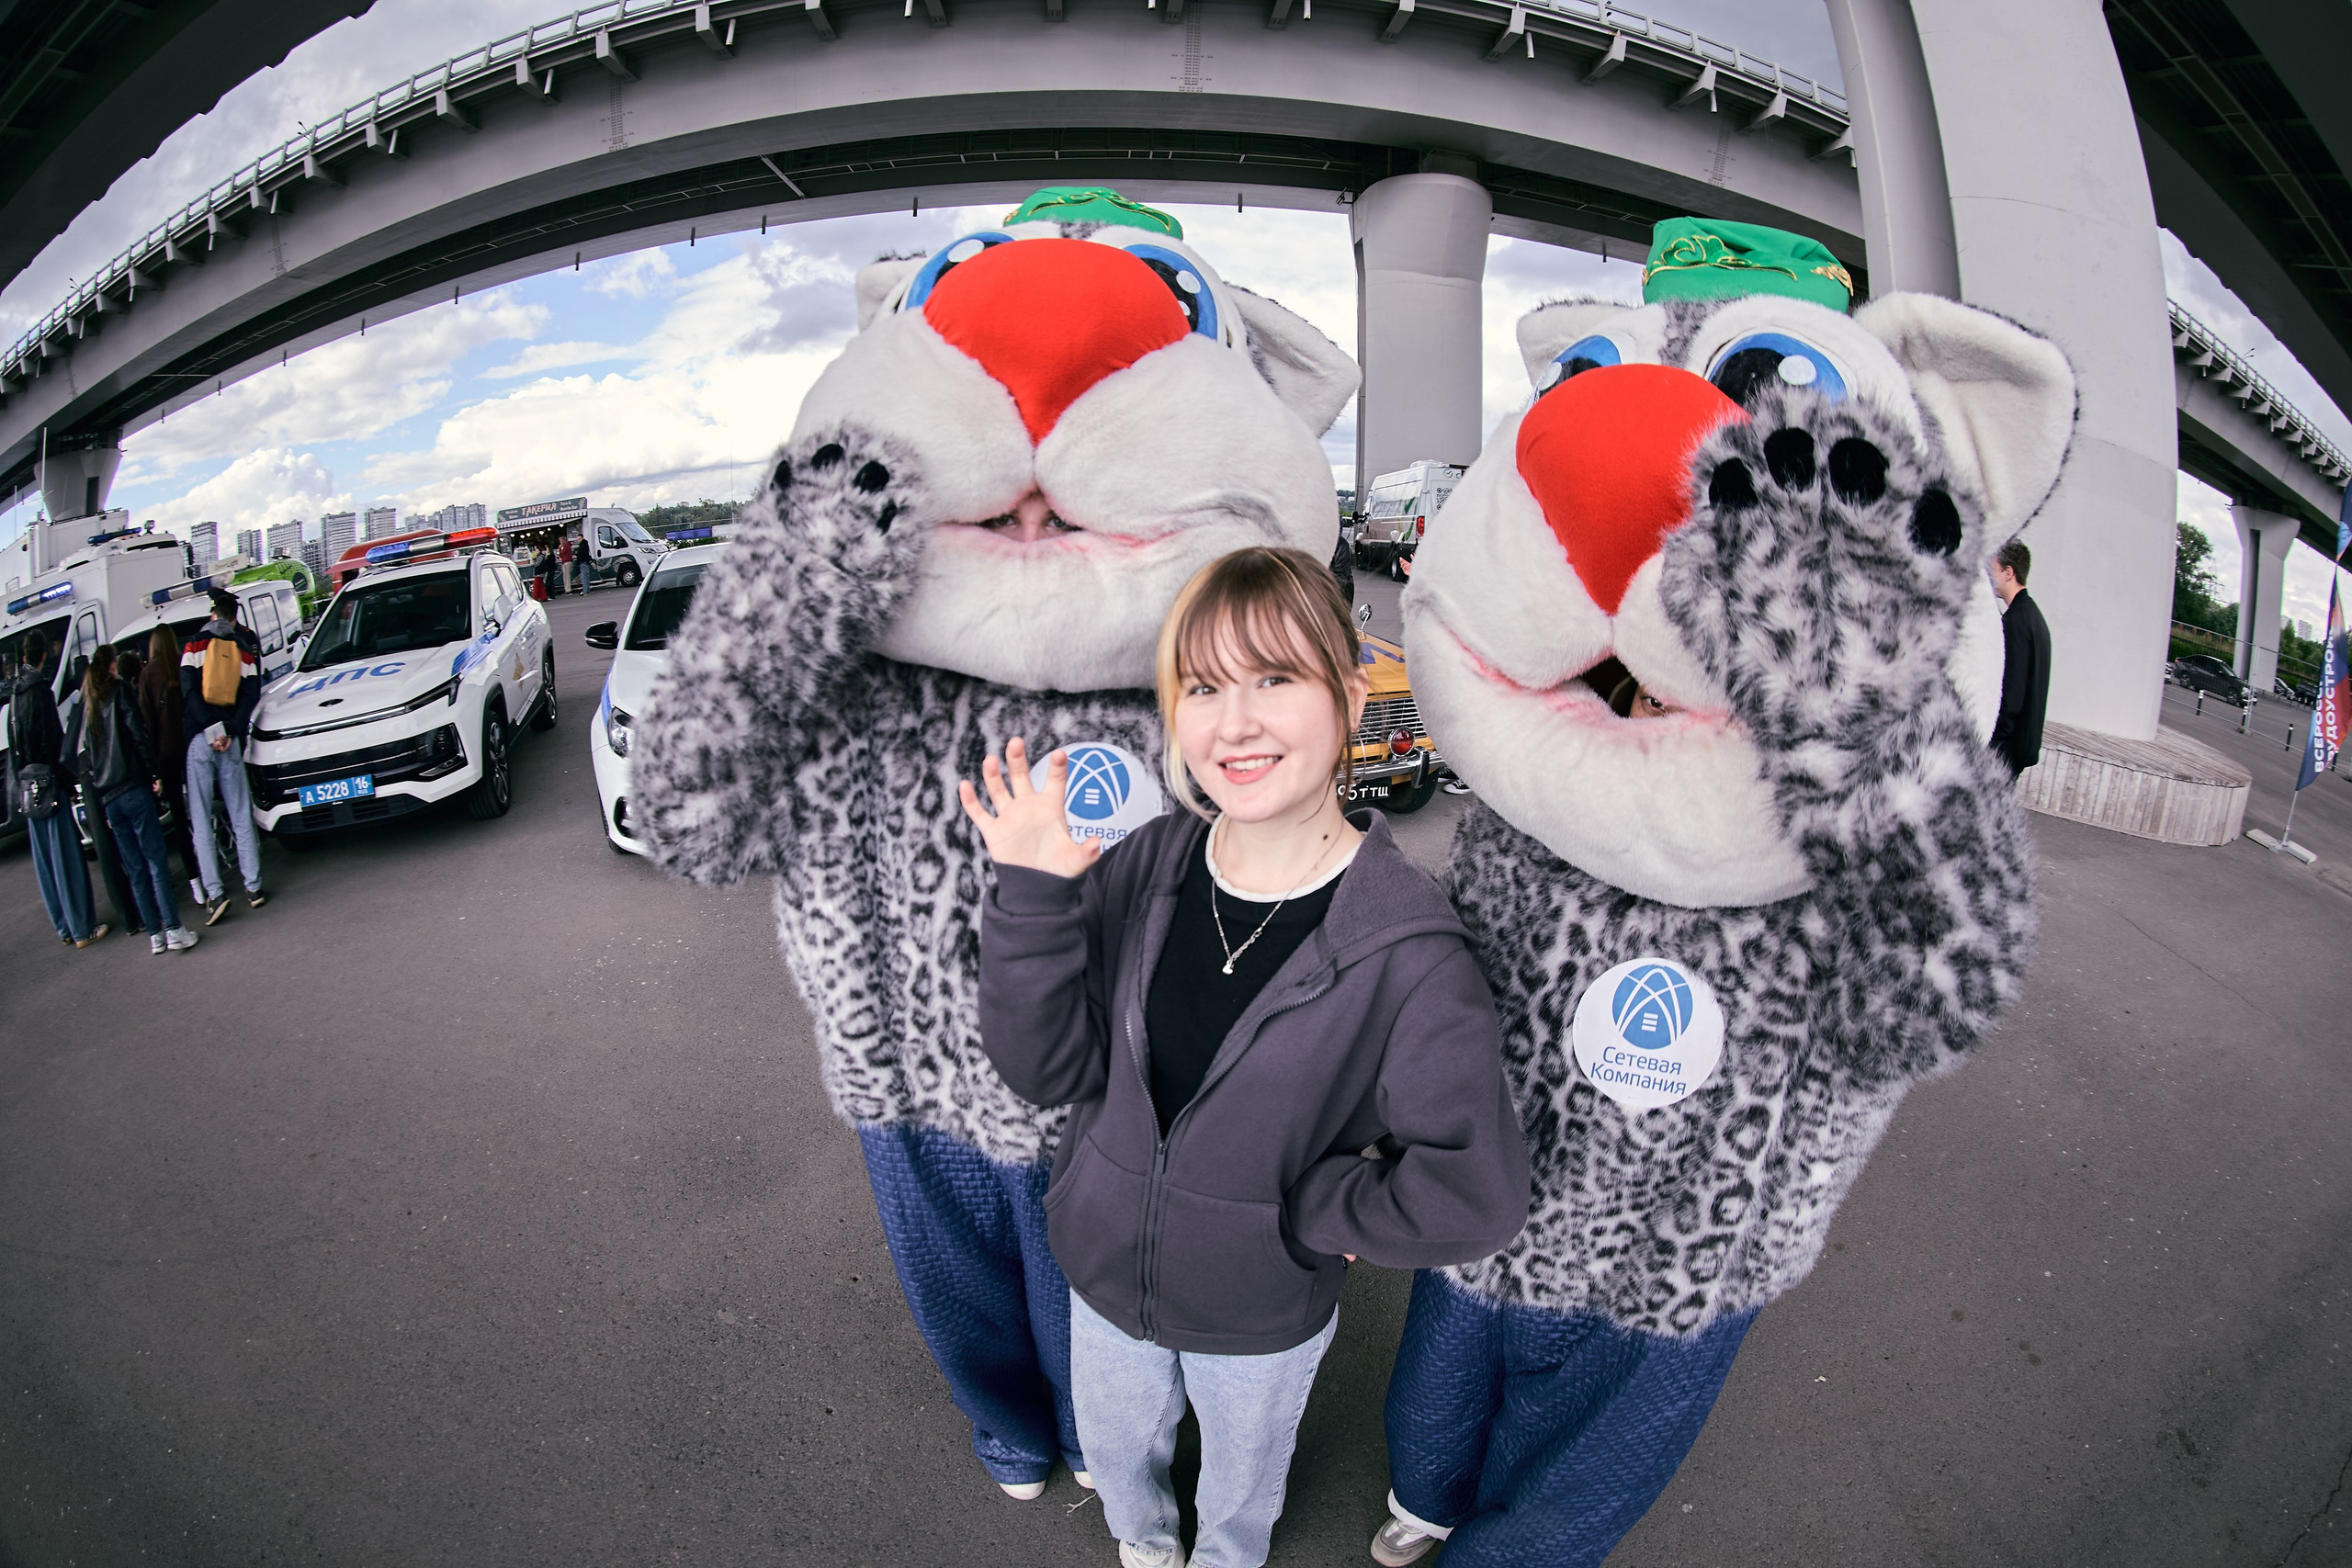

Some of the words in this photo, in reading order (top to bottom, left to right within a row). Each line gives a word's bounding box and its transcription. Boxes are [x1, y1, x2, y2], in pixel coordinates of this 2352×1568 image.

[521, 502, 557, 517] ТАКЕРИЯ
[288, 662, 406, 700] ДПС
[316, 781, 349, 801] 5228
[355, 776, 368, 790] 16
[1067, 825, 1127, 840] тевая
[1602, 1045, 1682, 1076] Сетевая
[1589, 1062, 1687, 1096] Компания
